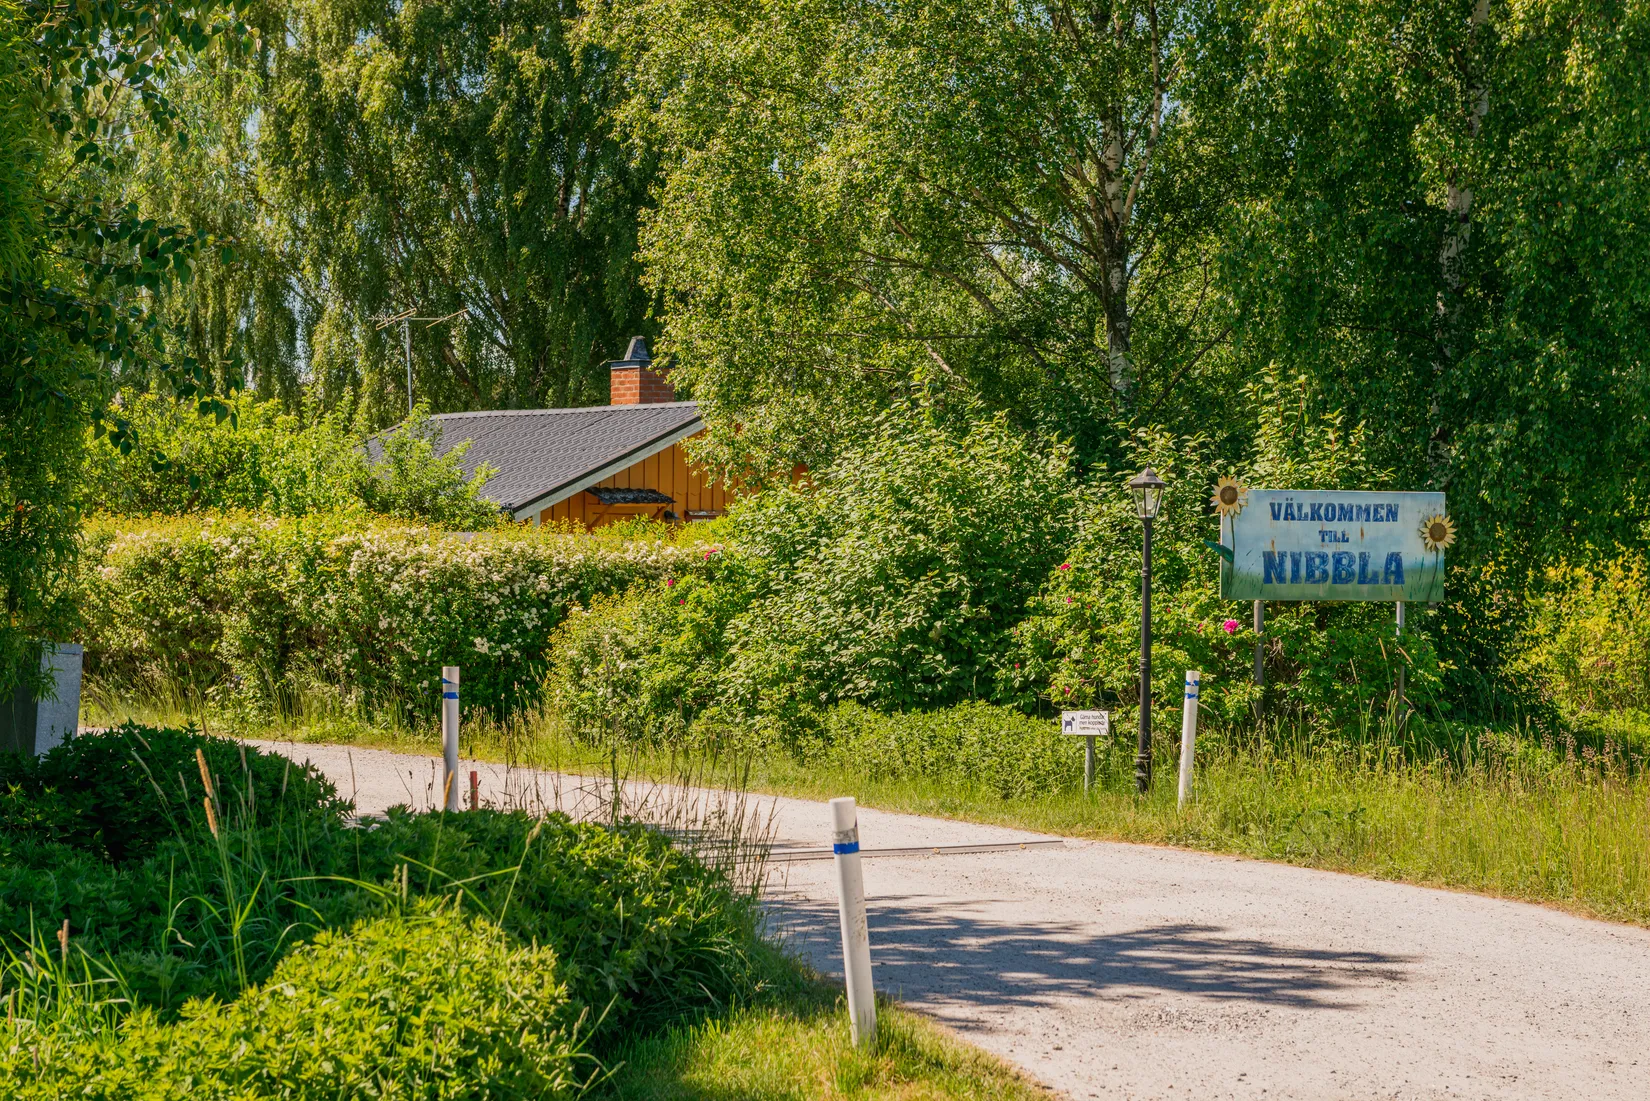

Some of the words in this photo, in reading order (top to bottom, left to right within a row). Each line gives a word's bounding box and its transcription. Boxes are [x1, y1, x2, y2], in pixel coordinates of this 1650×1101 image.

[1269, 497, 1399, 522] VÄLKOMMEN
[1318, 530, 1350, 543] TILL
[1262, 550, 1406, 585] NIBBLA
